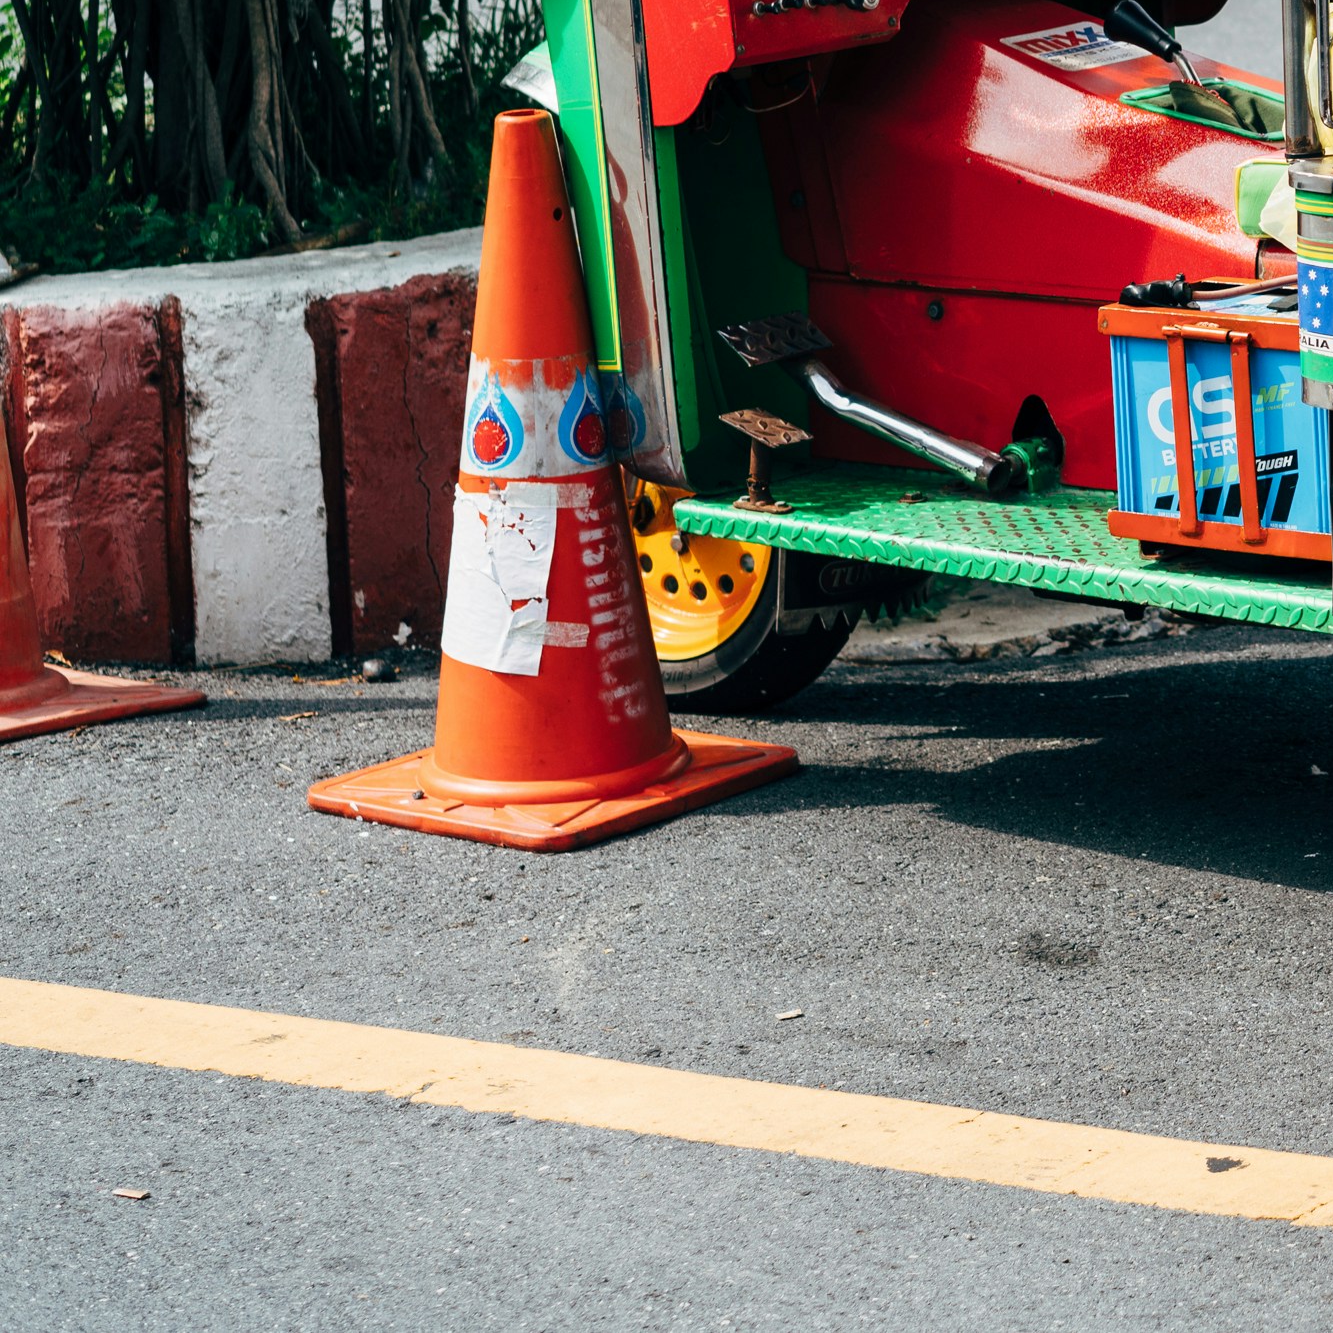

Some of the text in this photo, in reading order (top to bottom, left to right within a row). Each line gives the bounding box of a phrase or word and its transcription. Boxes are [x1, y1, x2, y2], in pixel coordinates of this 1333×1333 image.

[1300, 335, 1330, 350] ALIA
[1256, 382, 1295, 405] MF
[1161, 438, 1238, 466] BTER
